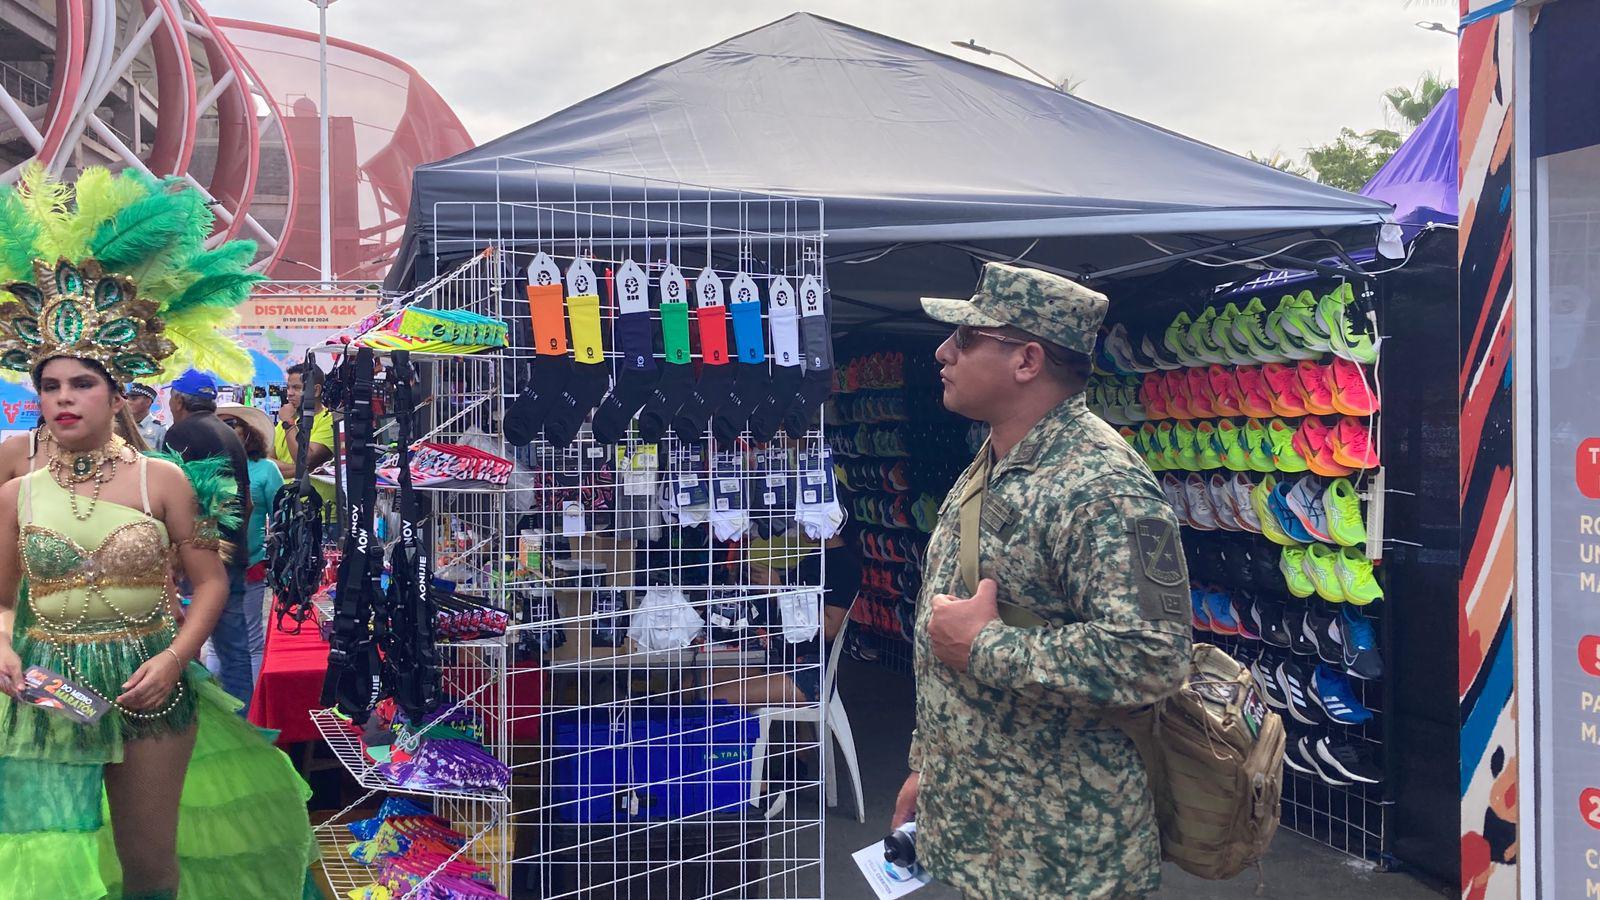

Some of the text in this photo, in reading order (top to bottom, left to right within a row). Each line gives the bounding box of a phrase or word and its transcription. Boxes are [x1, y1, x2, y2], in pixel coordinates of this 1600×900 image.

[255, 305, 356, 316] DISTANCIA 42K
[418, 555, 427, 602] AONIJIE
